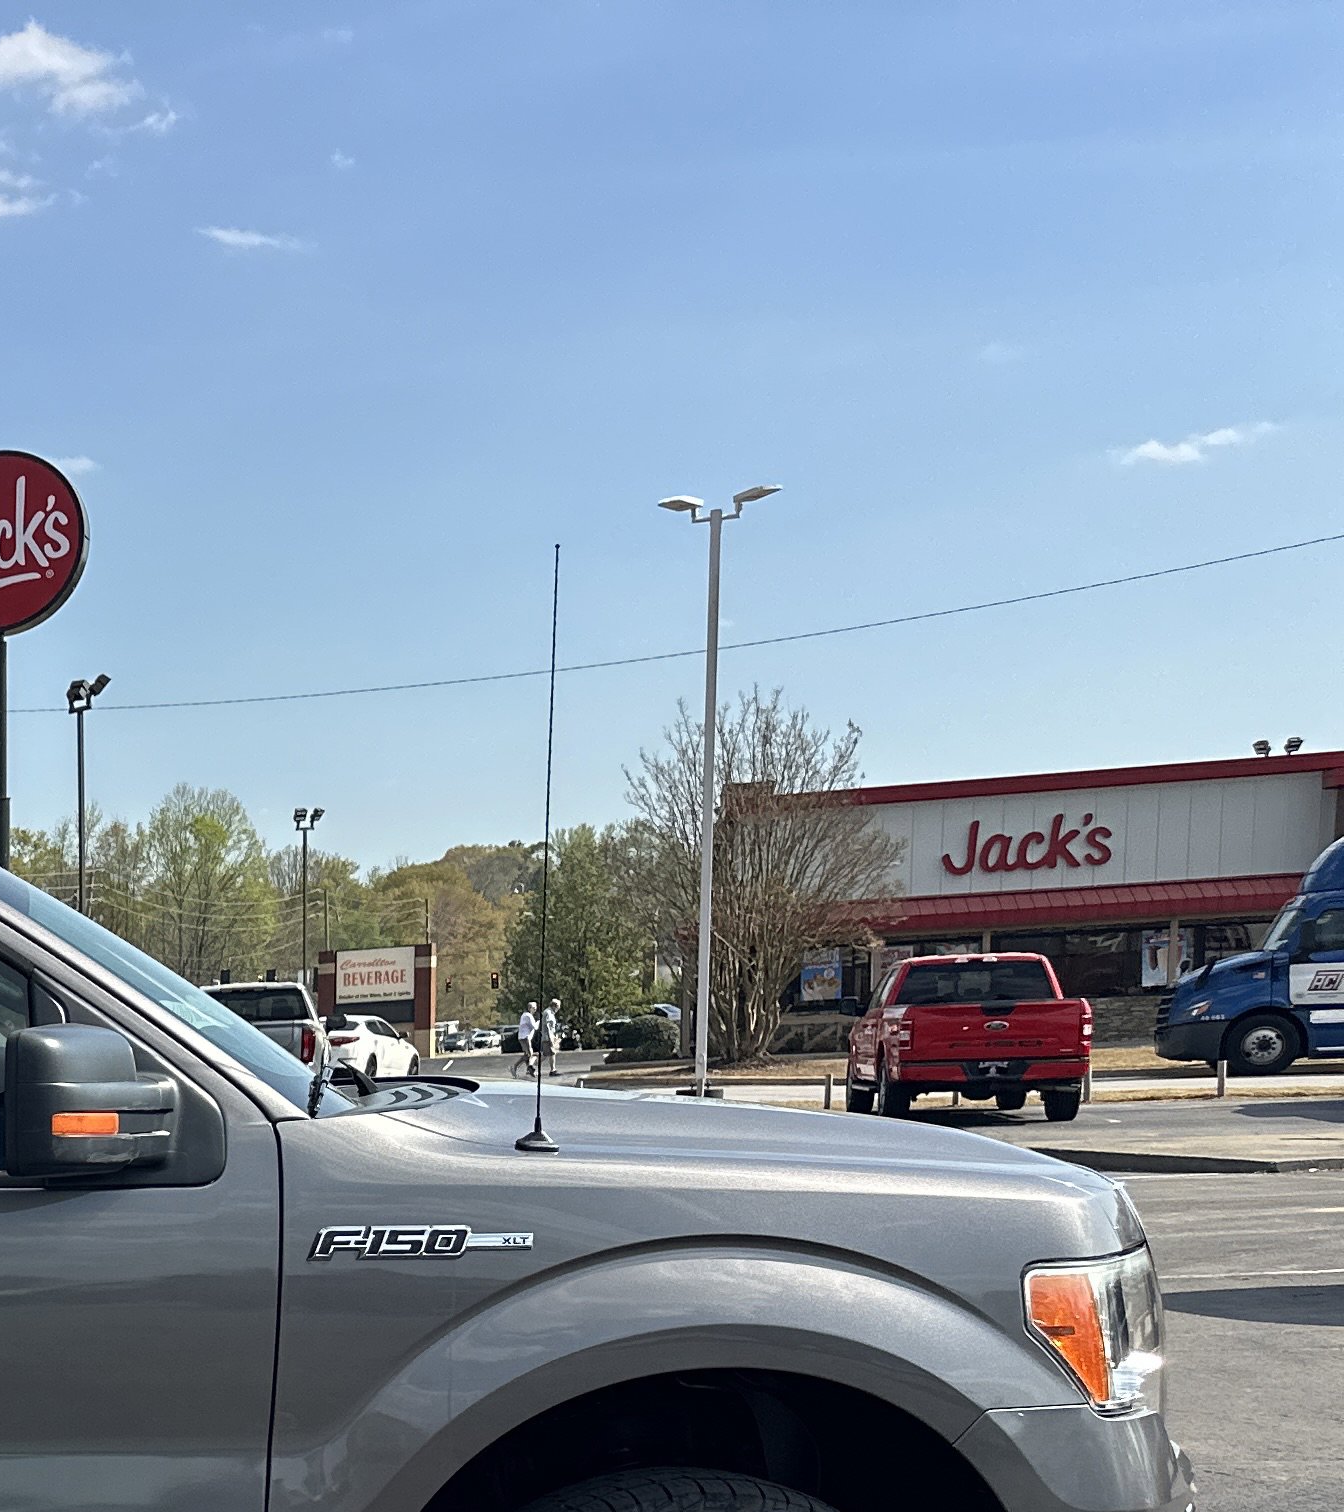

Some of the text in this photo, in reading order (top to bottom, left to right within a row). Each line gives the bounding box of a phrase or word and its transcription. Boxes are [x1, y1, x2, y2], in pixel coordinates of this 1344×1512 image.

[941, 812, 1113, 876] Jack's
[343, 968, 407, 987] BEVERAGE
[308, 1225, 530, 1260] F-150 XLT
